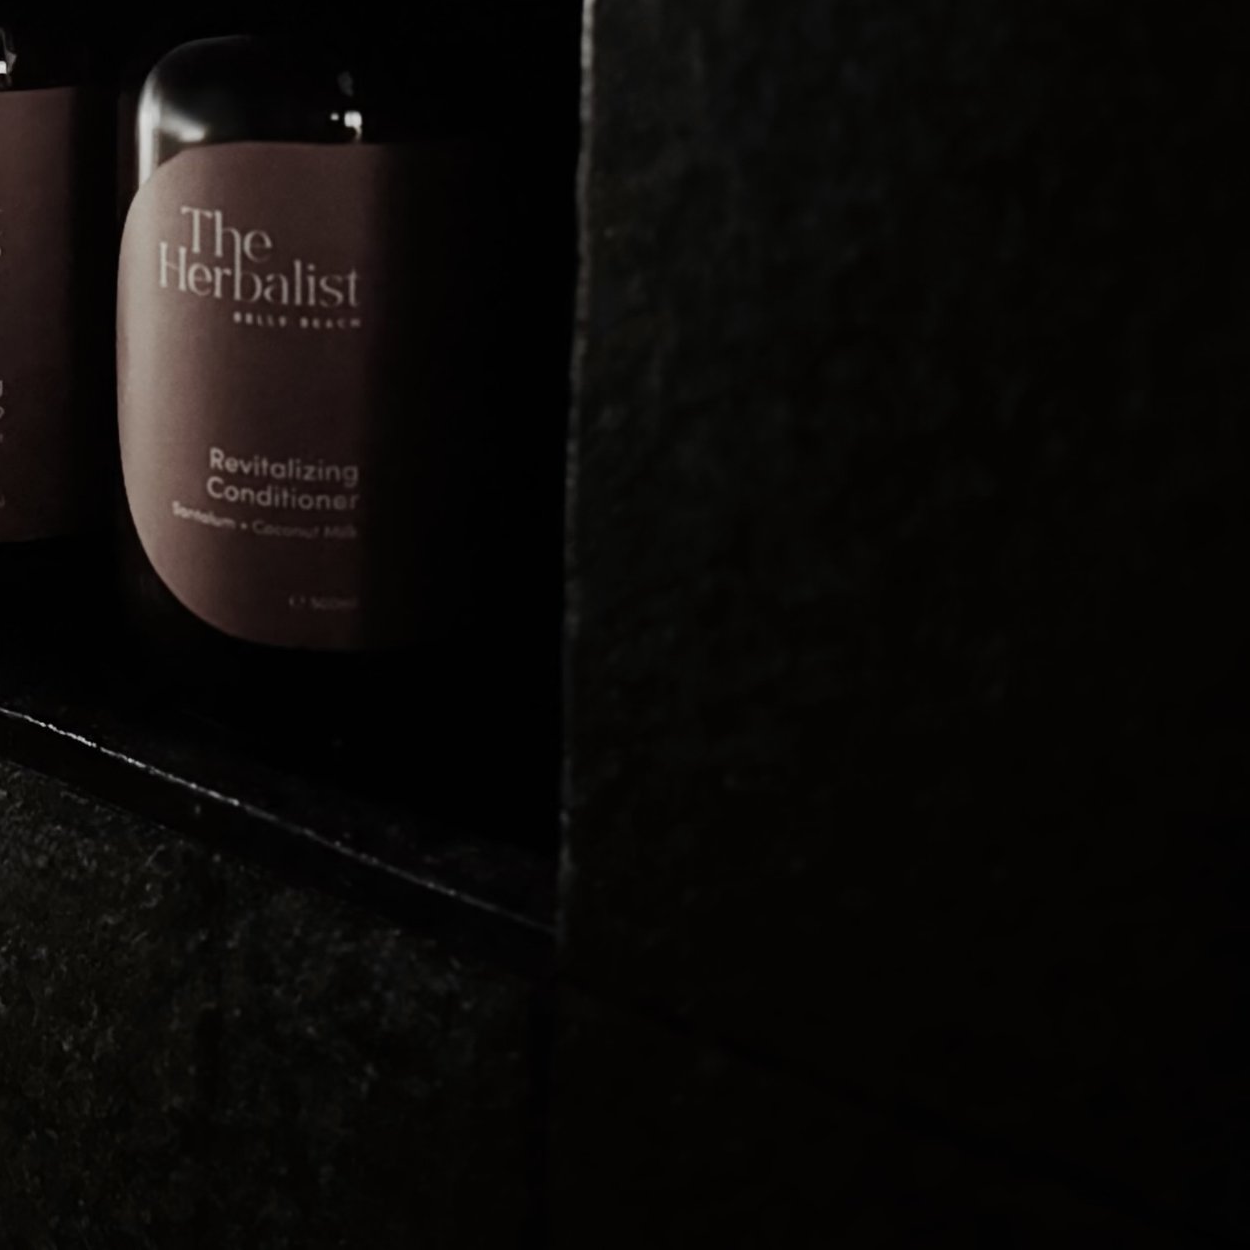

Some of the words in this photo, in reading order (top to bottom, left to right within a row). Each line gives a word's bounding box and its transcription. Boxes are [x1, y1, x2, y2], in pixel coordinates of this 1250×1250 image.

[180, 205, 273, 263] The
[159, 241, 361, 308] Herbalist
[209, 446, 360, 489] Revitalizing
[206, 476, 360, 510] Conditioner
